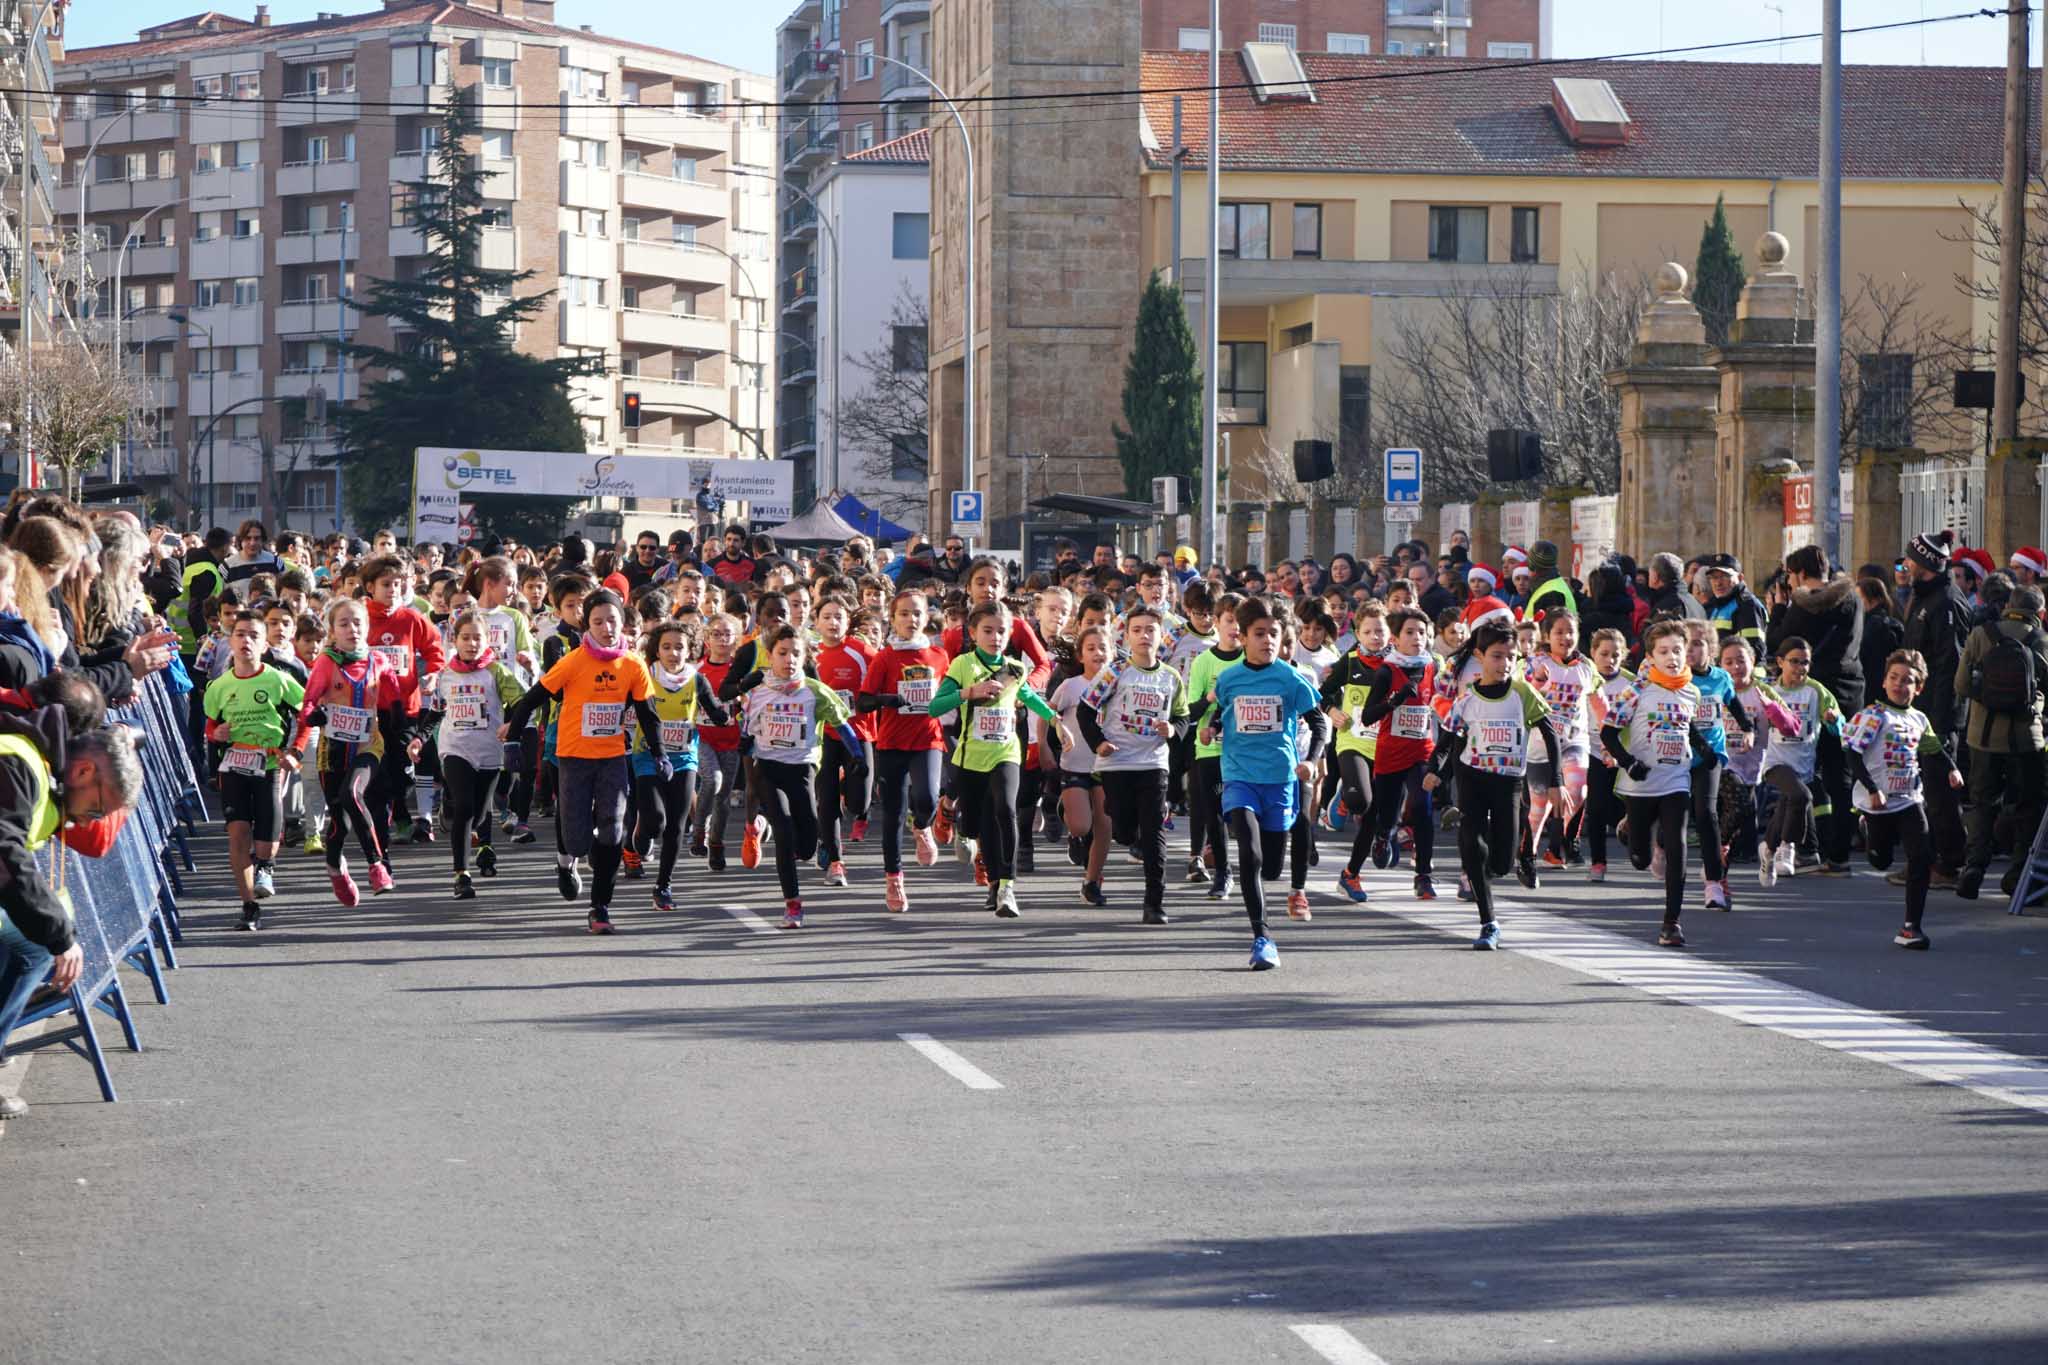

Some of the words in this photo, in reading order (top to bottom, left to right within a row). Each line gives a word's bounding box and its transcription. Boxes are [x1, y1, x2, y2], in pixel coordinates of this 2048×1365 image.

[457, 467, 516, 480] SETEL
[714, 475, 775, 486] Ayuntamiento
[714, 486, 724, 495] de
[727, 486, 775, 496] Salamanca
[957, 494, 977, 519] P
[460, 528, 471, 537] 30
[1133, 691, 1161, 708] 7053
[450, 704, 475, 719] 7204
[1239, 704, 1271, 721] 7035
[331, 713, 361, 731] 6976
[663, 728, 685, 743] 028
[768, 723, 793, 737] 7217
[1481, 727, 1512, 743] 7005
[1656, 740, 1683, 756] 7096
